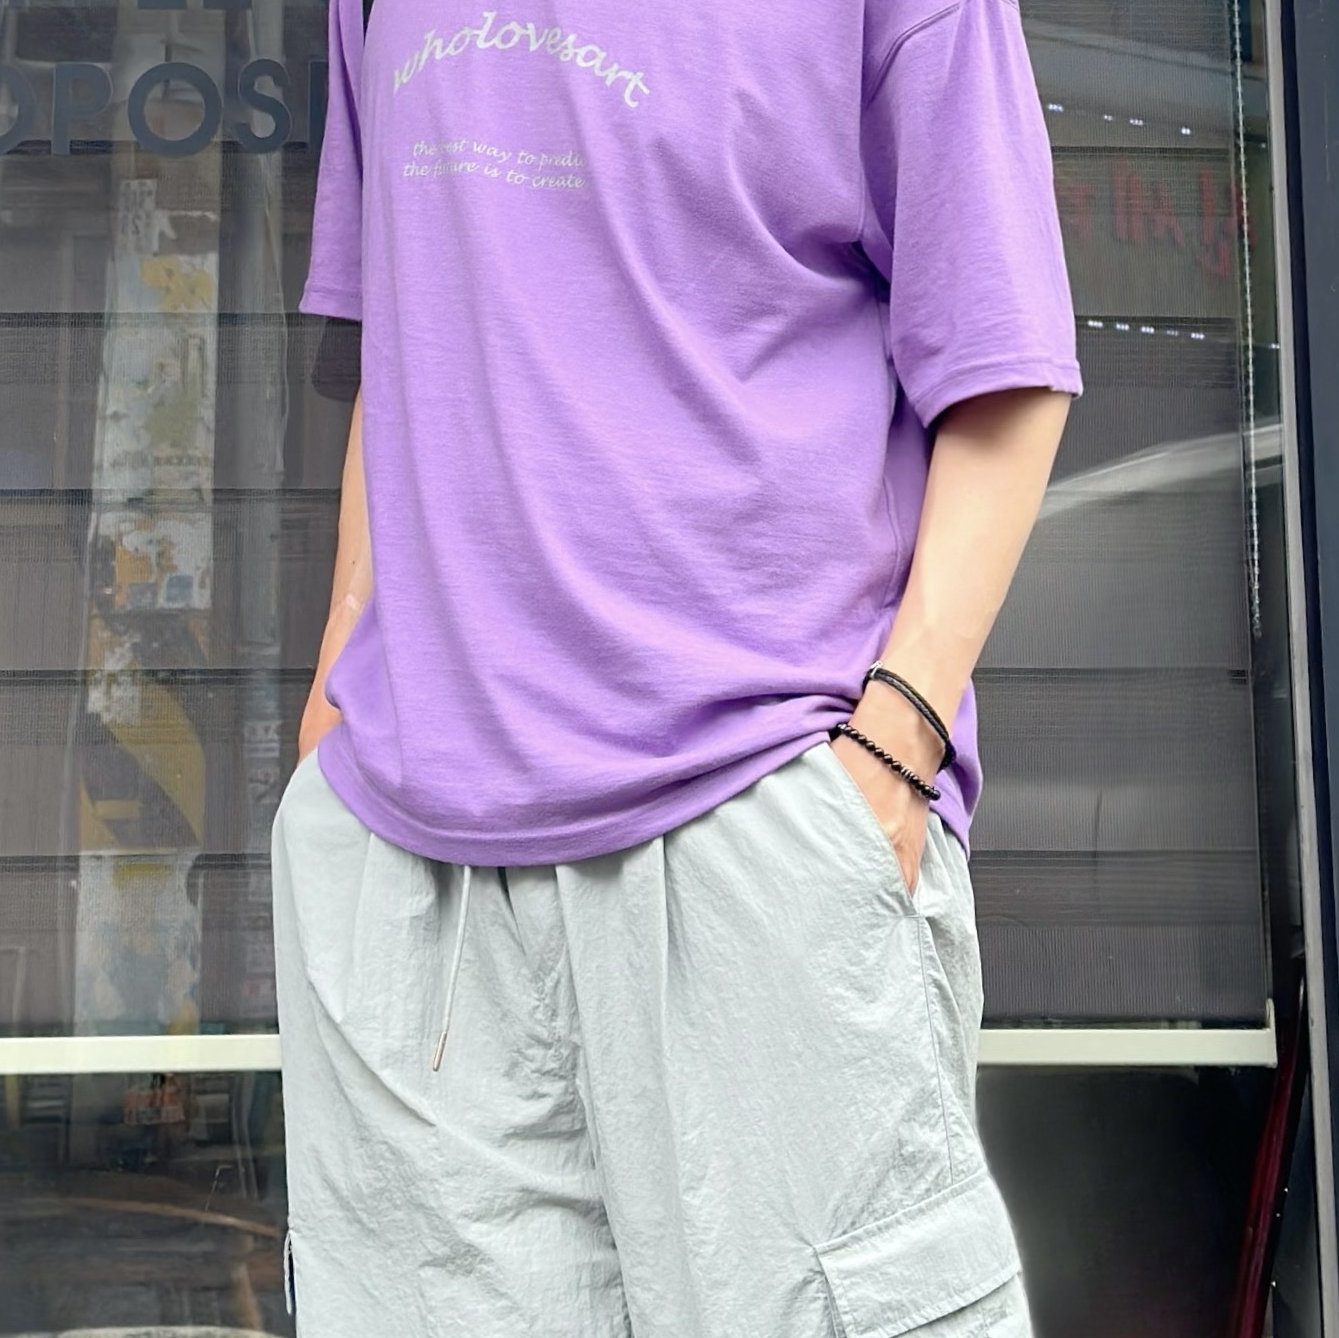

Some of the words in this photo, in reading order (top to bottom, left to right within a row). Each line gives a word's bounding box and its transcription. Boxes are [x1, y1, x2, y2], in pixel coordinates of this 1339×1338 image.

[393, 10, 650, 108] wholovesart
[472, 140, 513, 164] way
[516, 149, 538, 165] to
[403, 161, 431, 177] the
[483, 163, 502, 179] is
[505, 168, 529, 185] to
[531, 175, 586, 190] create
